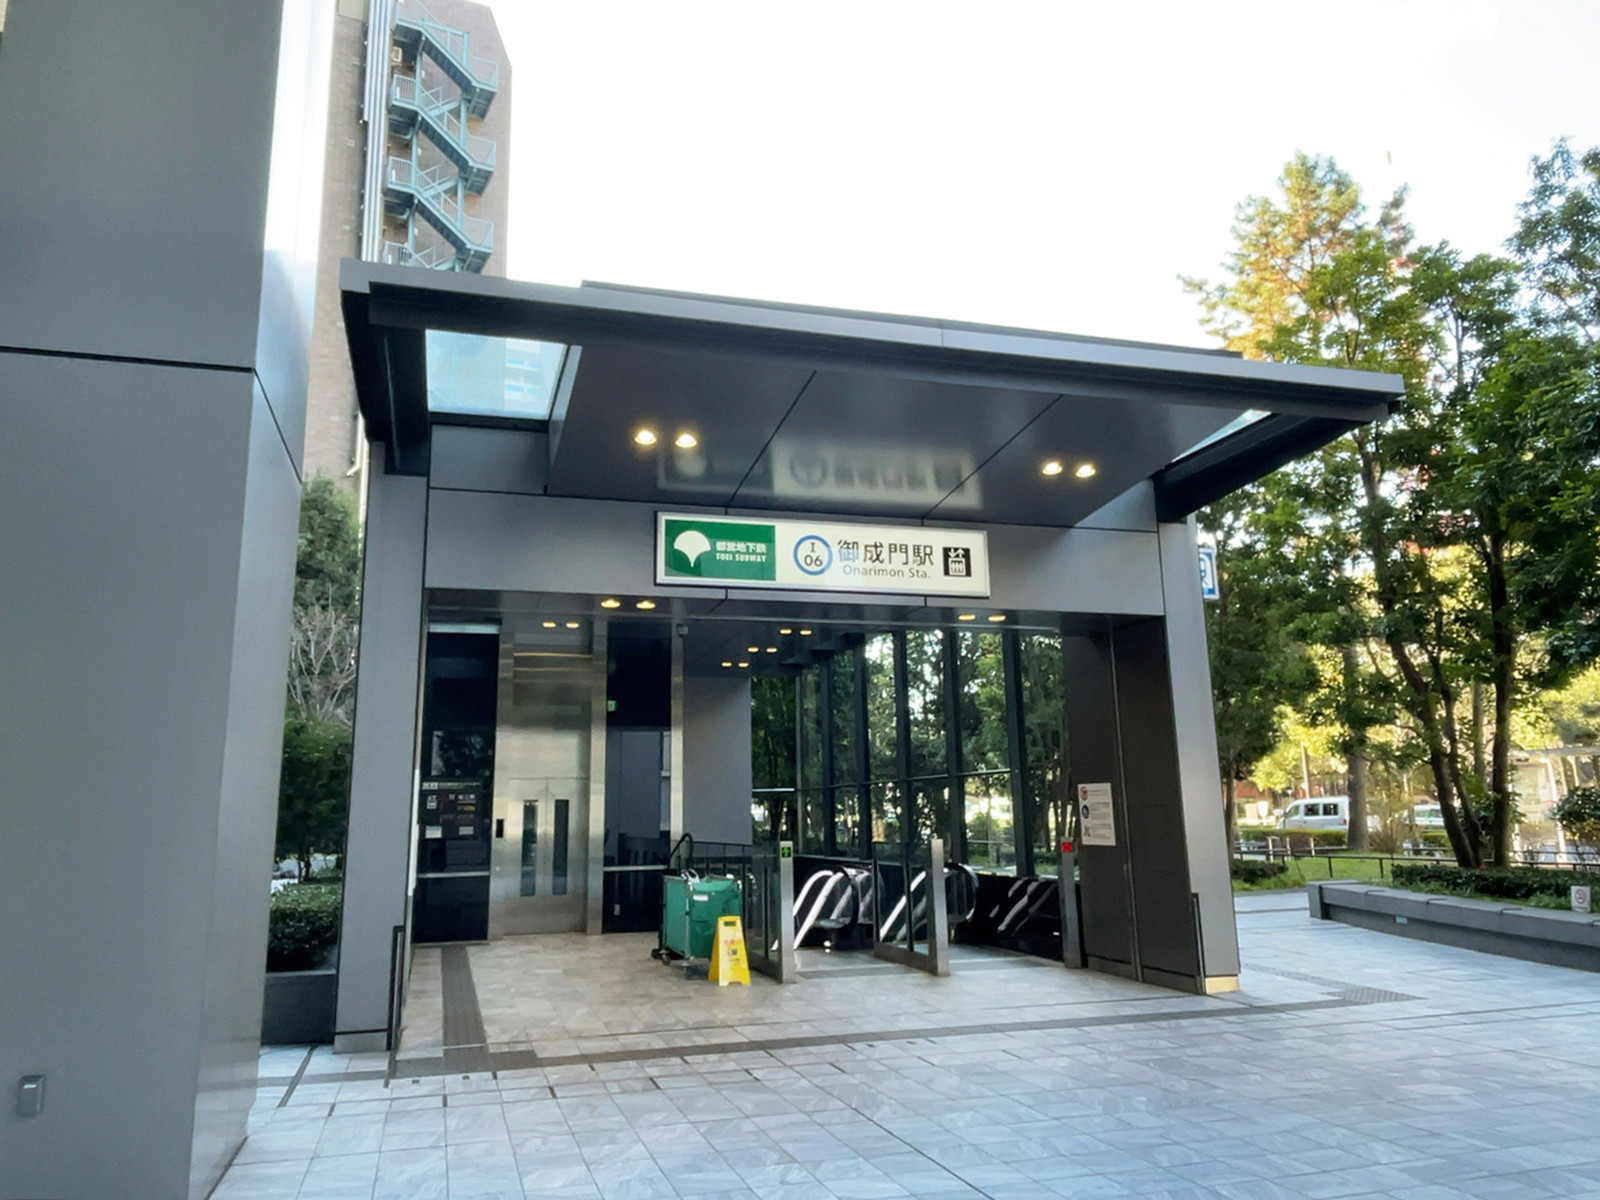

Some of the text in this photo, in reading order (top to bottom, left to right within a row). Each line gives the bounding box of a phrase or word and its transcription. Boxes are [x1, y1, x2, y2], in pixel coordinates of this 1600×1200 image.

[735, 554, 766, 562] SUBWAY
[837, 539, 934, 566] 御成門駅
[804, 554, 823, 567] 06
[843, 564, 931, 579] Onarimon Sta.
